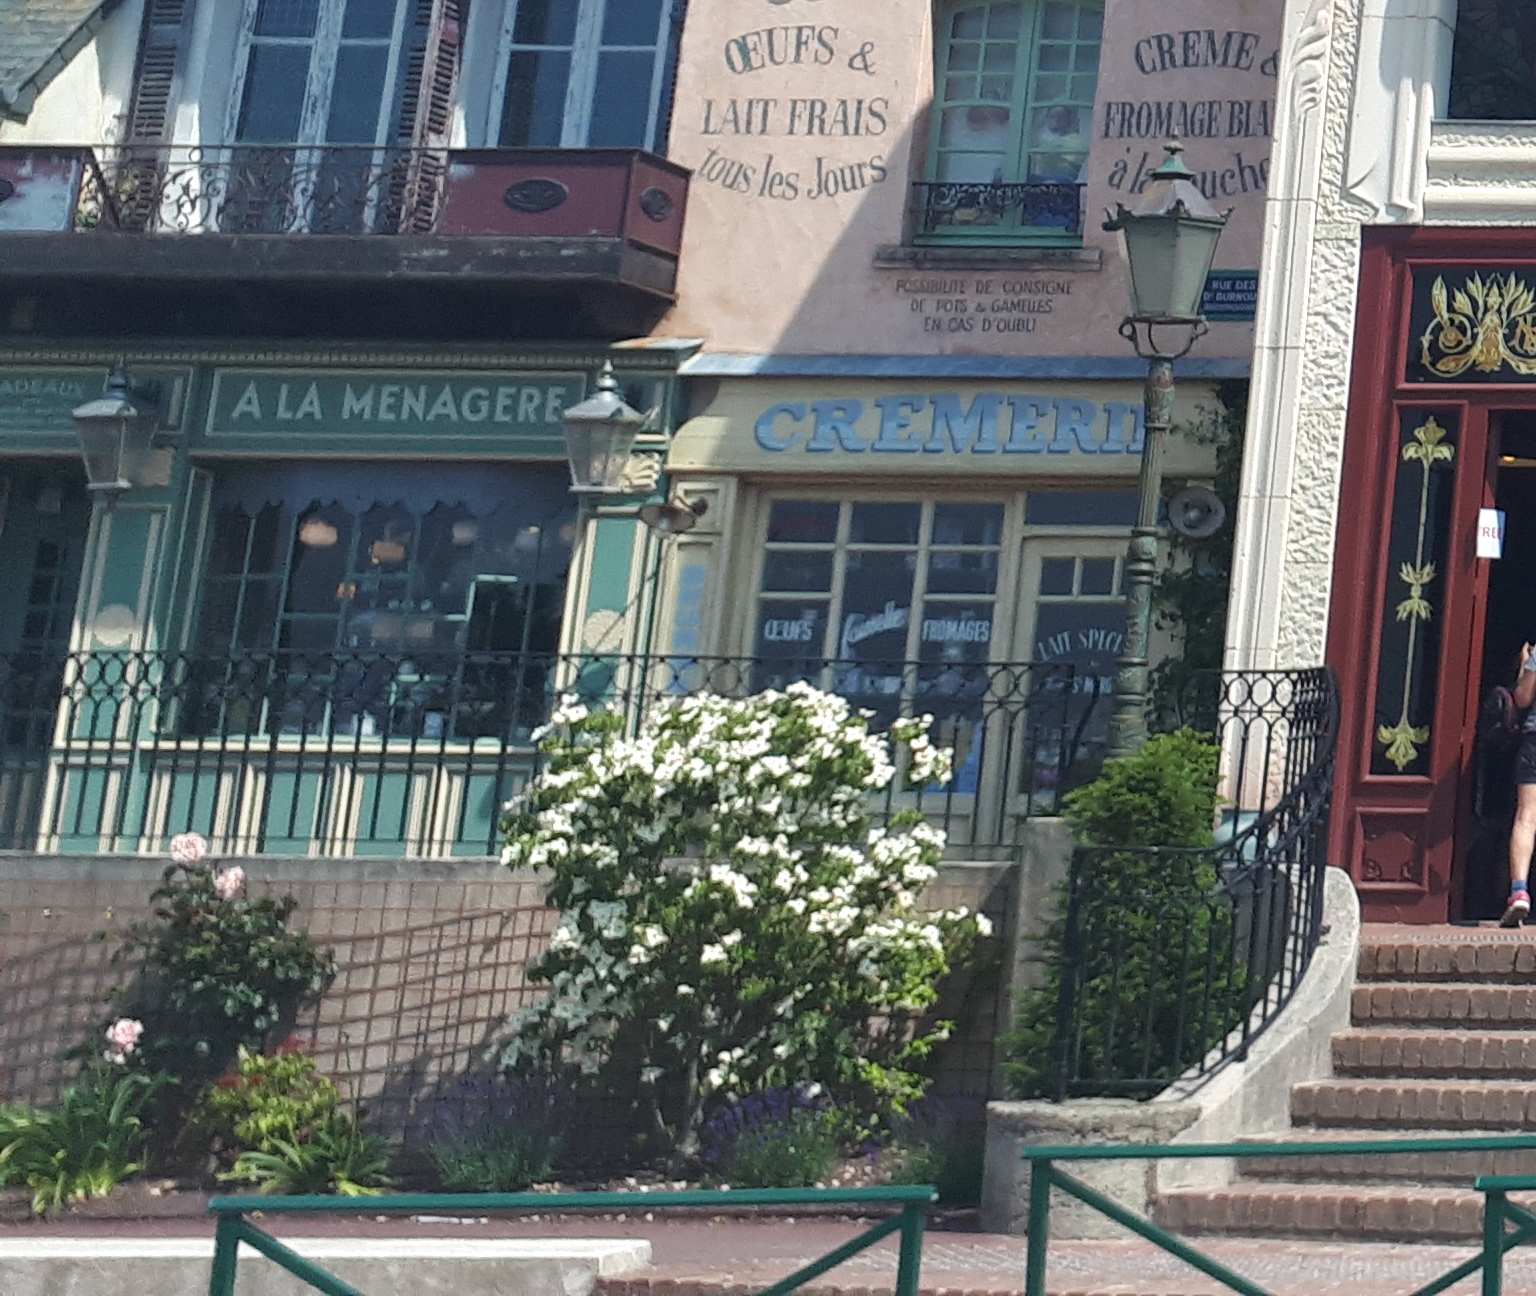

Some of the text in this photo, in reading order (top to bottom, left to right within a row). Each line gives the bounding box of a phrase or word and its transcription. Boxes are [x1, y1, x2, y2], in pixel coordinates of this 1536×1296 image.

[724, 25, 877, 76] ŒUFS &
[1134, 29, 1262, 75] CREME
[700, 97, 889, 136] LAIT FRAIS
[1102, 99, 1272, 139] FROMAGE BLA
[698, 144, 757, 193] tous
[758, 154, 800, 200] les
[975, 279, 994, 295] DE
[1002, 279, 1075, 295] CONSIGNE
[1211, 280, 1256, 290] RUE DES
[1216, 292, 1257, 302] BURNOU
[910, 298, 927, 312] DE
[936, 298, 968, 313] POTS
[991, 298, 1053, 313] GAMELLES
[924, 316, 942, 332] EN
[948, 317, 975, 332] CAS
[230, 379, 567, 423] A LA MENAGERE
[922, 619, 991, 642] FROMAGES
[1038, 628, 1123, 661] LAIT SPECI
